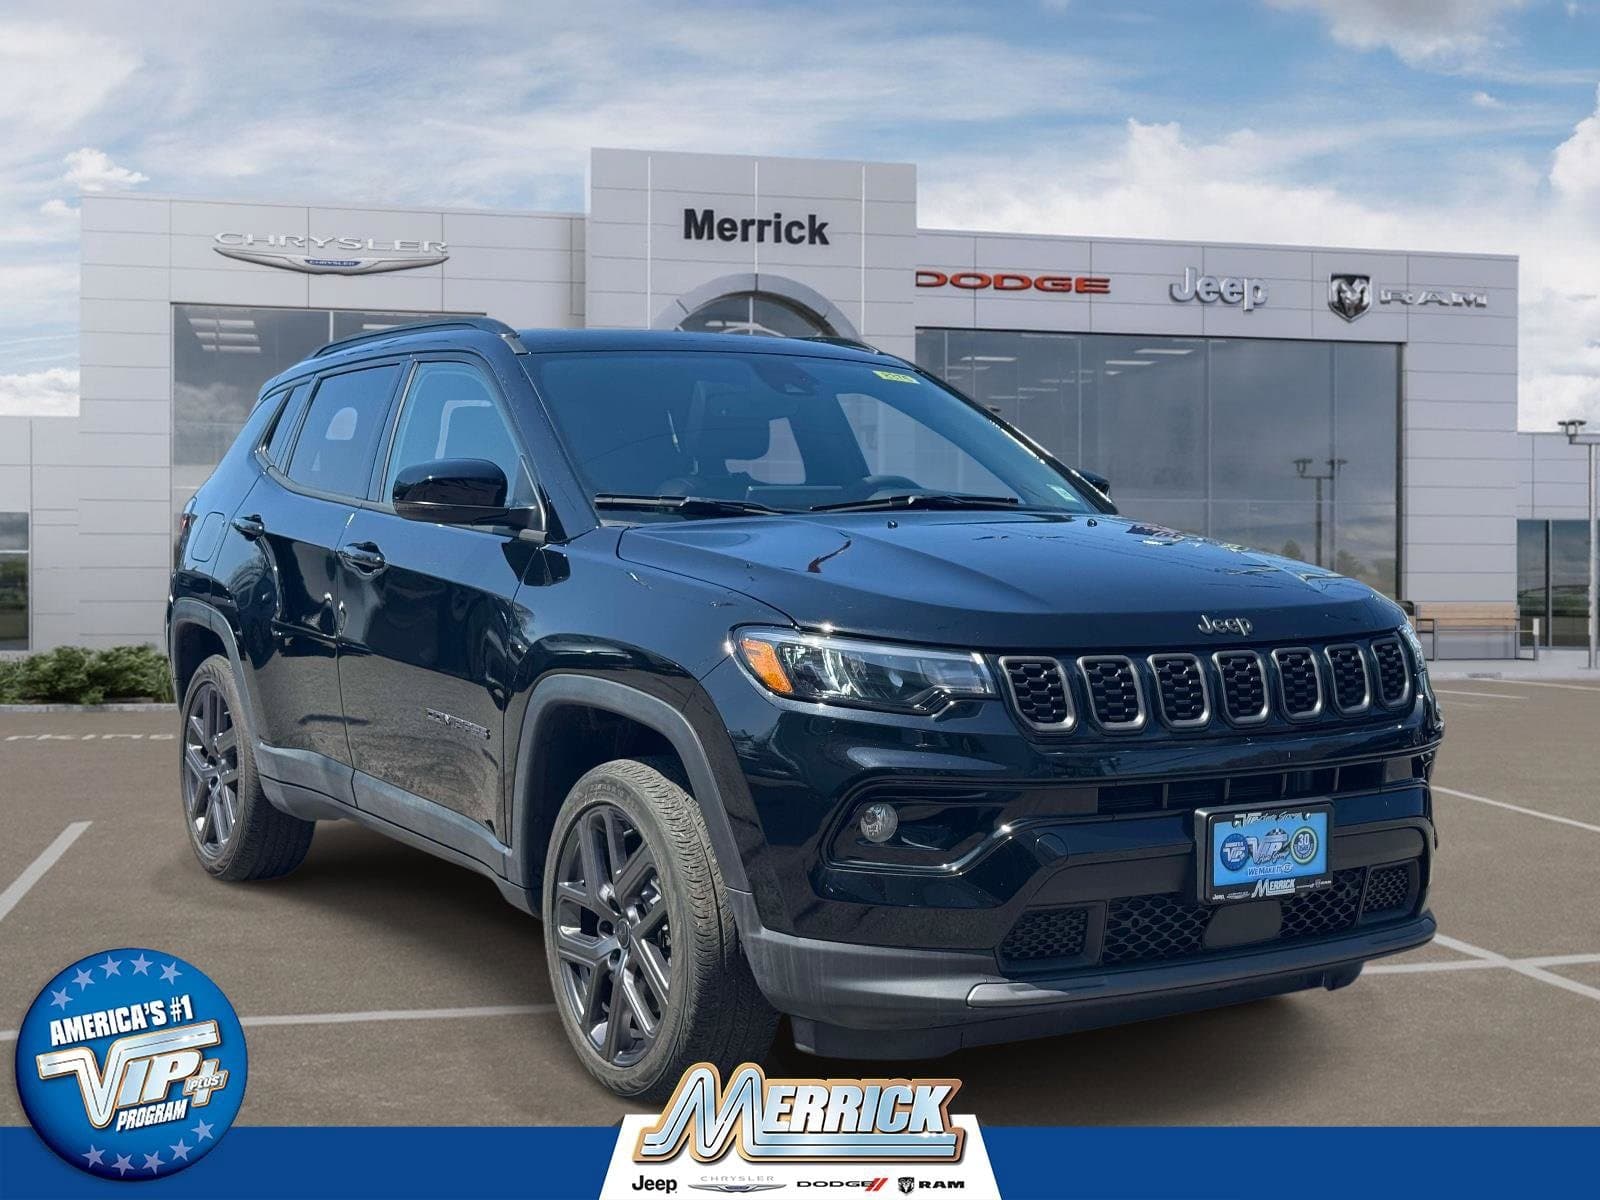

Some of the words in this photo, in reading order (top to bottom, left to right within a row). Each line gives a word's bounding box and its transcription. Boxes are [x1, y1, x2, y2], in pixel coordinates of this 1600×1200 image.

[684, 208, 830, 246] Merrick
[214, 232, 449, 254] CHRYSLER
[915, 271, 1111, 294] DODGE
[1169, 267, 1268, 312] Jeep
[1379, 289, 1488, 308] RAM
[1197, 613, 1253, 637] Jeep
[1298, 833, 1310, 846] 30
[1251, 878, 1296, 898] MERRICK
